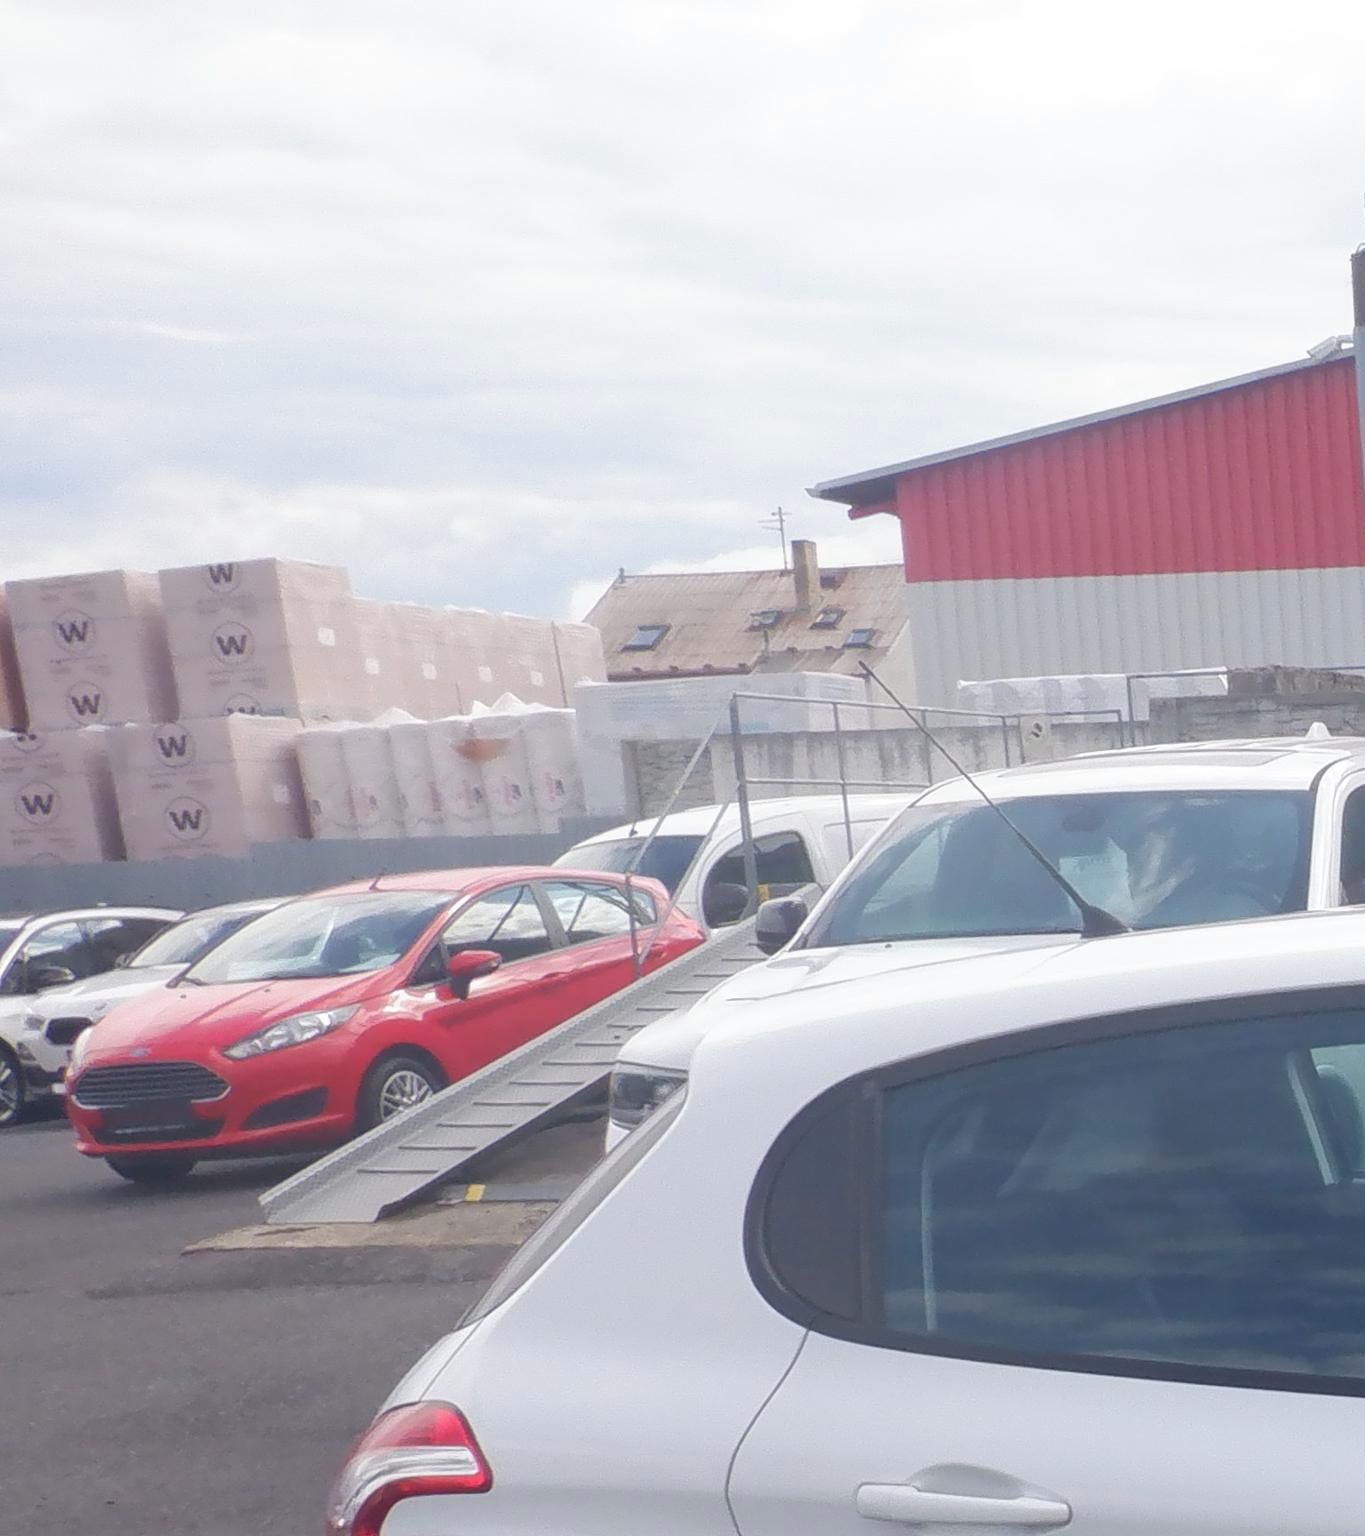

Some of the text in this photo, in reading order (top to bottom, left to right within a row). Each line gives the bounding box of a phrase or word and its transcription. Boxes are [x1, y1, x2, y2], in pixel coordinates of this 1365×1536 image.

[208, 563, 234, 585] W
[57, 620, 90, 644] W
[215, 634, 248, 656] W
[70, 693, 101, 716] W
[157, 734, 188, 758] W
[20, 794, 54, 816] W
[168, 808, 203, 831] W
